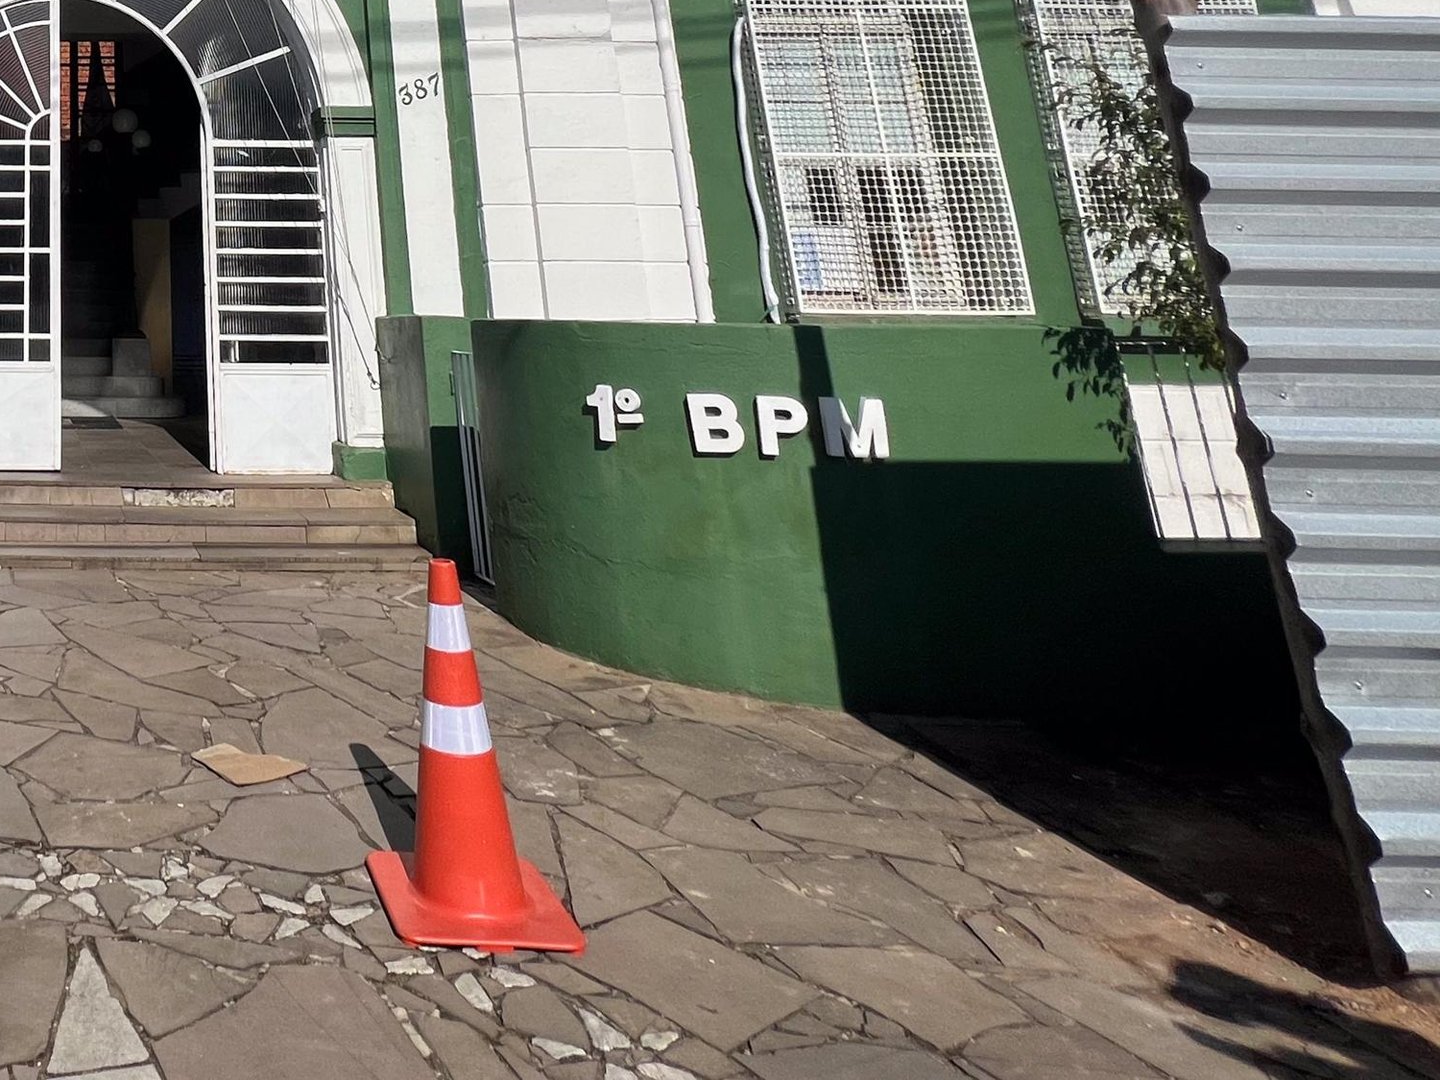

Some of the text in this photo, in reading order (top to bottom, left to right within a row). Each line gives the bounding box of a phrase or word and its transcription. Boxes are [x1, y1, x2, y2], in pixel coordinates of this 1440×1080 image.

[399, 72, 440, 106] 387
[586, 384, 891, 460] 1º BPM
